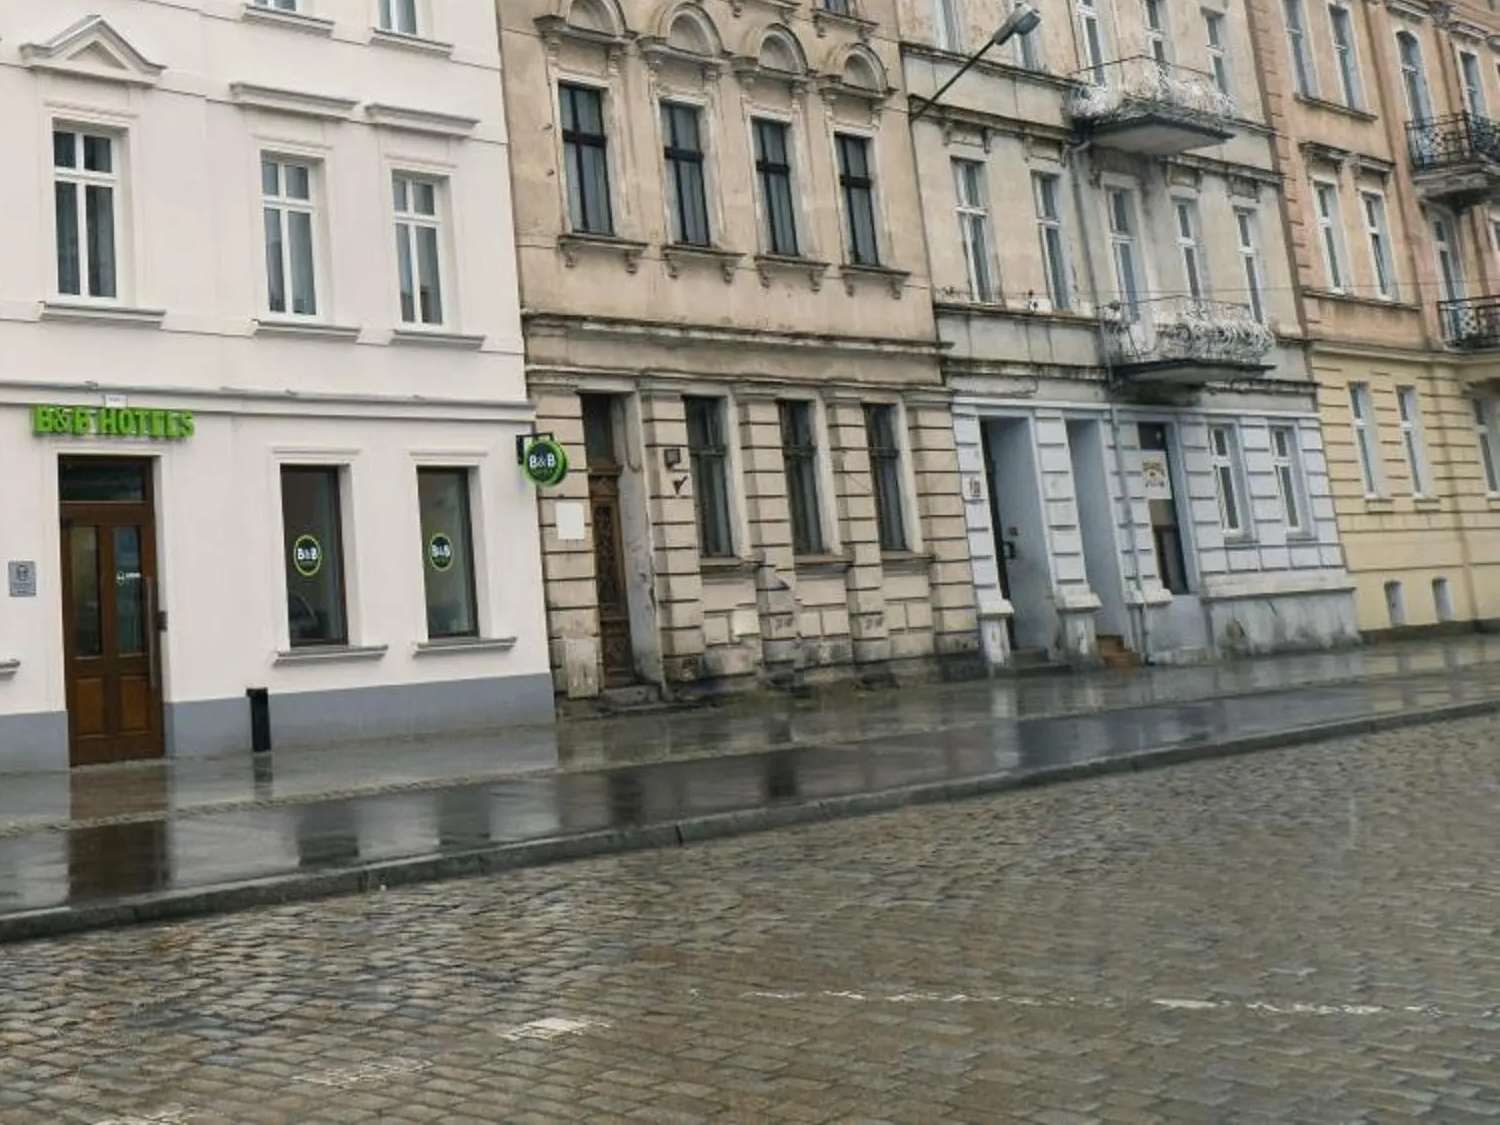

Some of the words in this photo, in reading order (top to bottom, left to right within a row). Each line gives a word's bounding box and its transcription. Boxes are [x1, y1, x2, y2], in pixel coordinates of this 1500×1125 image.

[34, 406, 90, 434] B&B
[99, 408, 195, 438] HOTELS
[529, 453, 557, 469] B&B
